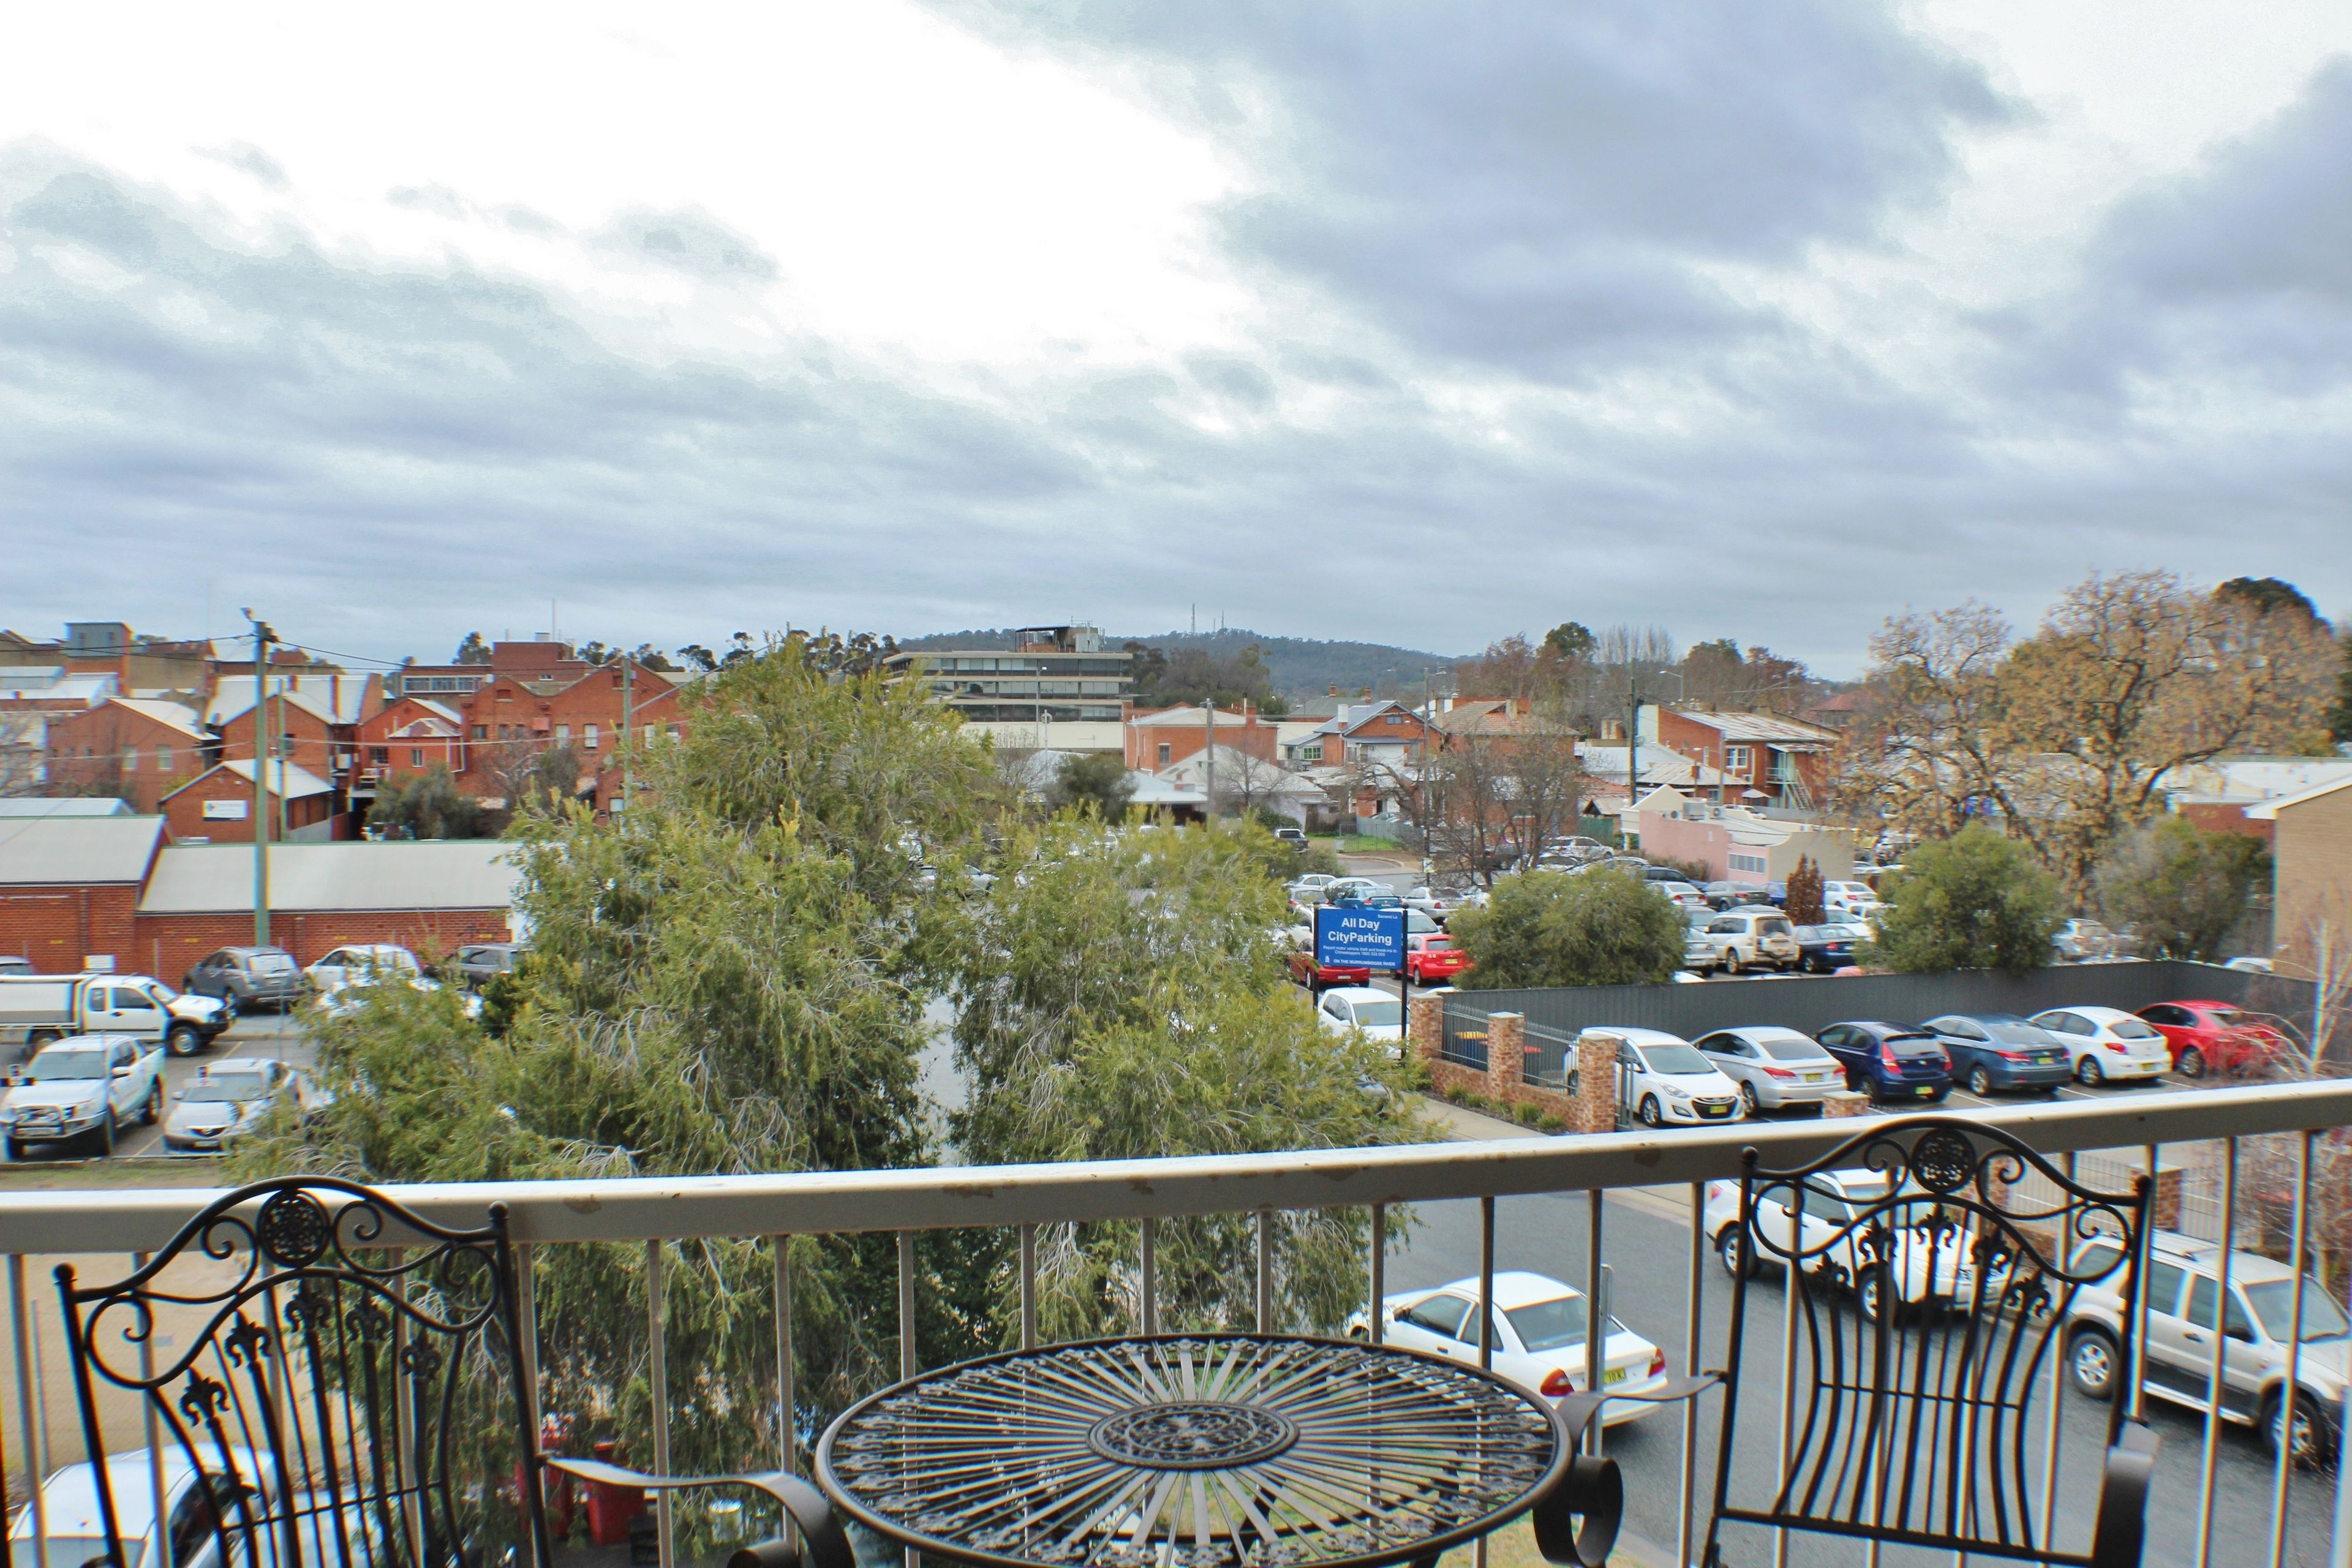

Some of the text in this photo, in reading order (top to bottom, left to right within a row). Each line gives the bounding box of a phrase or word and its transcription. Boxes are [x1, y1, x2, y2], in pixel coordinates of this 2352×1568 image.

[1341, 918, 1380, 931] All Day
[1328, 931, 1392, 946] CityParking
